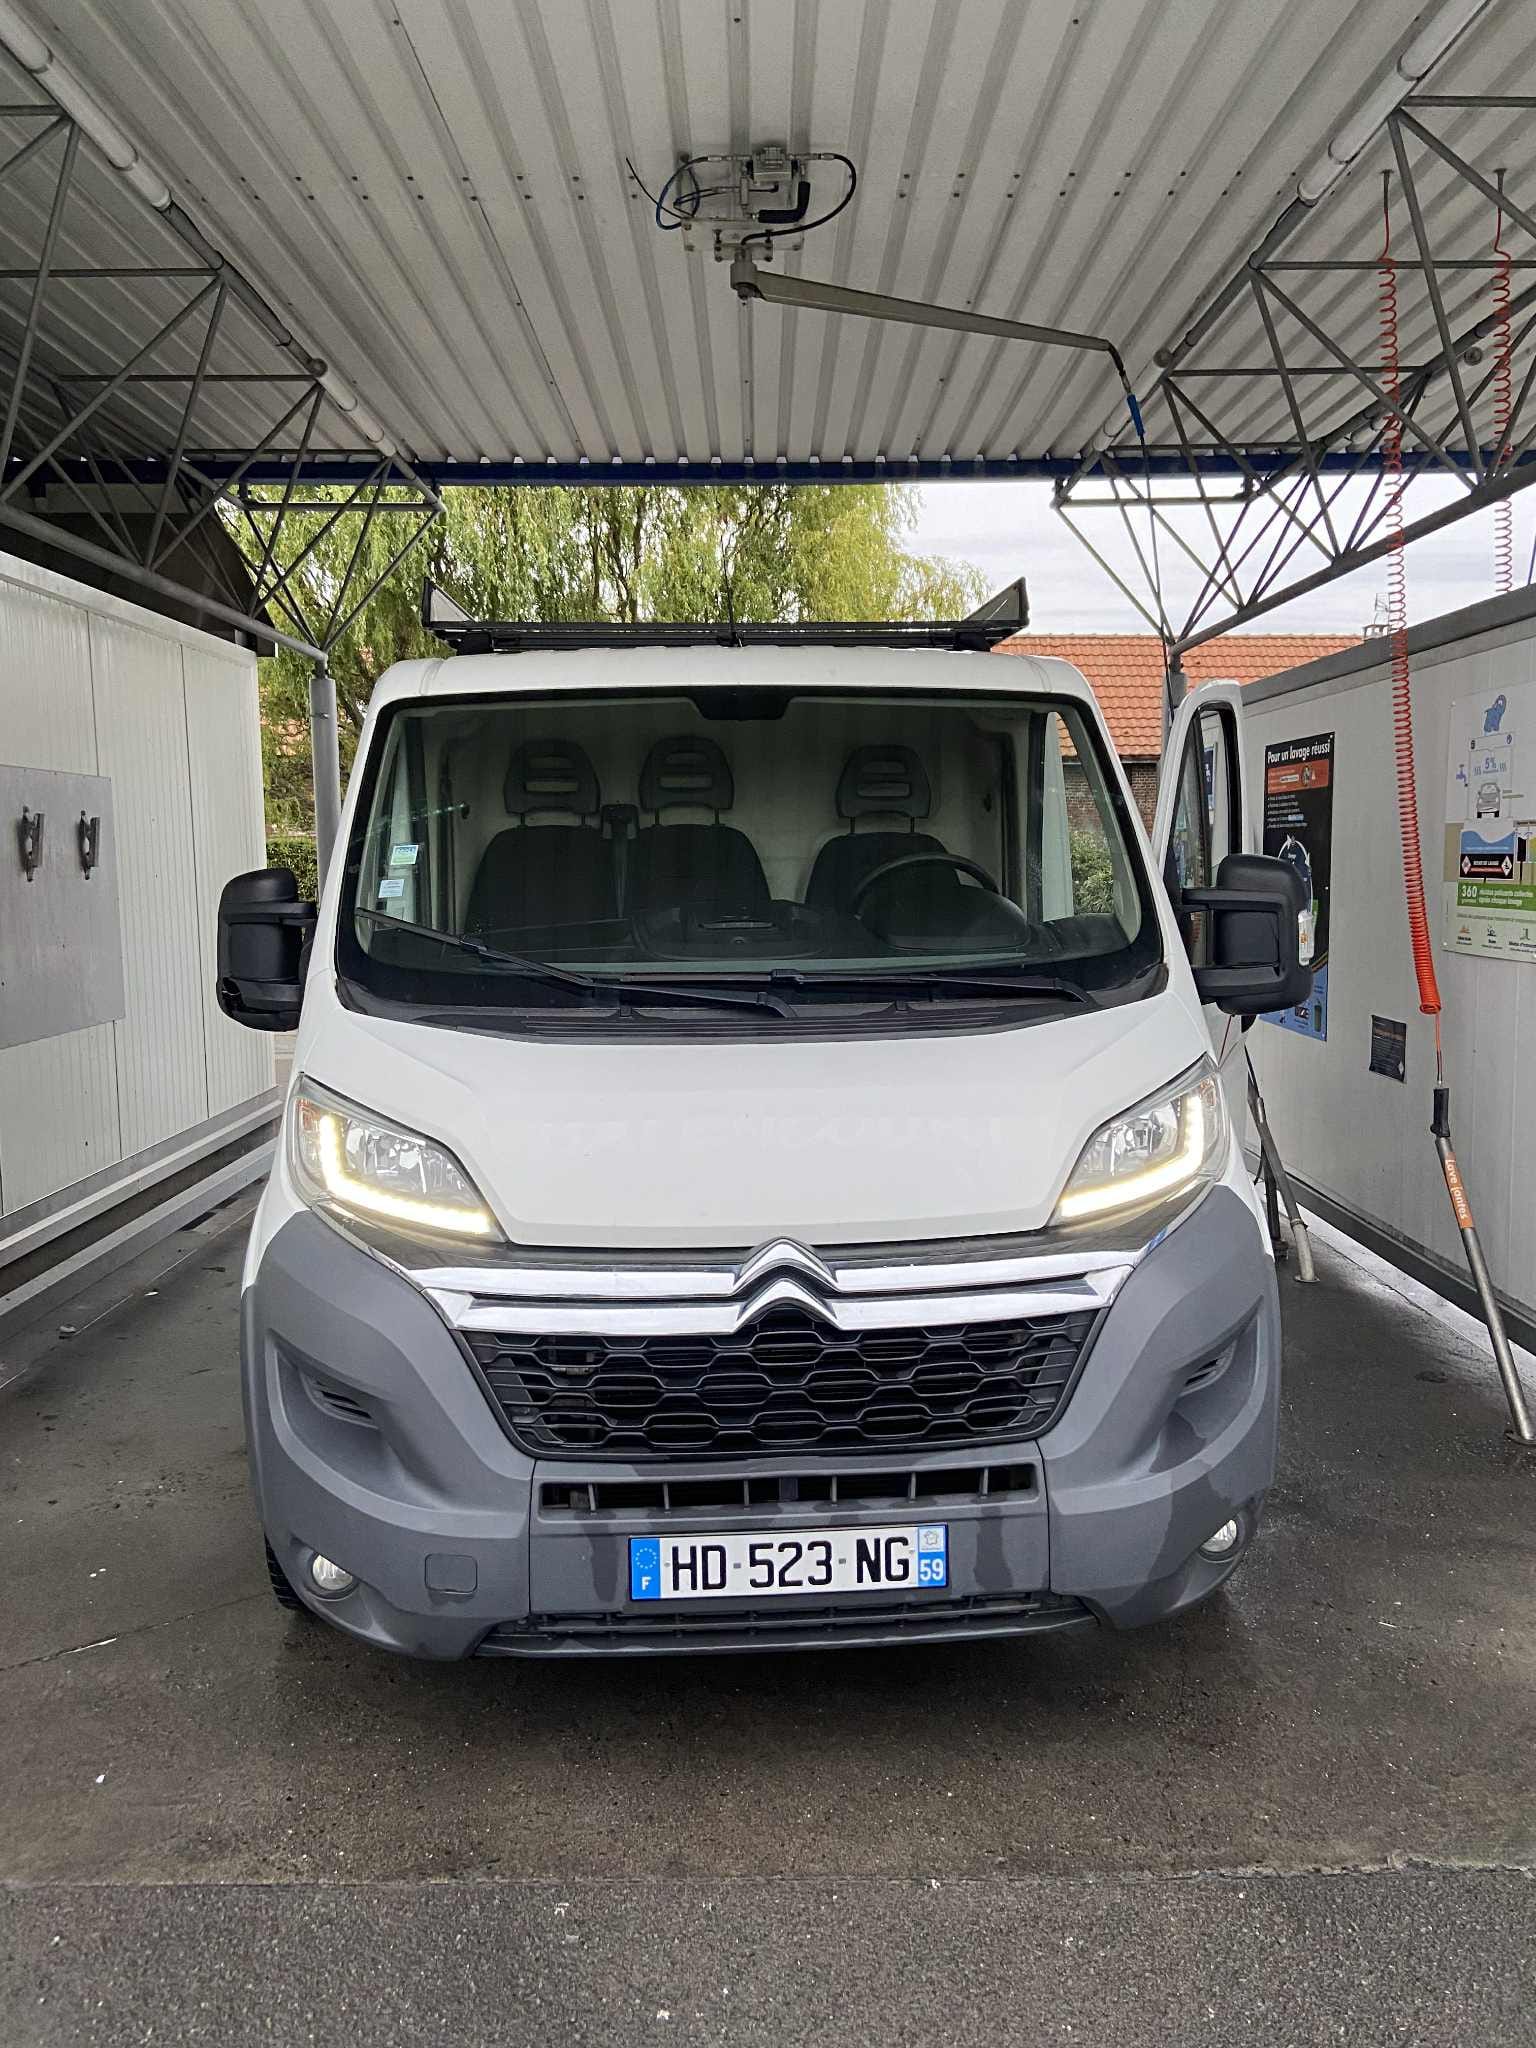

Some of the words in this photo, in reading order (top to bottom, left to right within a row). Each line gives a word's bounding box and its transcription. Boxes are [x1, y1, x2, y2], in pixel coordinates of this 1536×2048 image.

[1267, 751, 1280, 764] Pour
[1281, 750, 1289, 761] un
[1289, 745, 1311, 761] lavage
[1311, 739, 1331, 756] réussi
[1461, 884, 1478, 898] 360
[919, 1558, 944, 1581] 59
[640, 1576, 651, 1591] F
